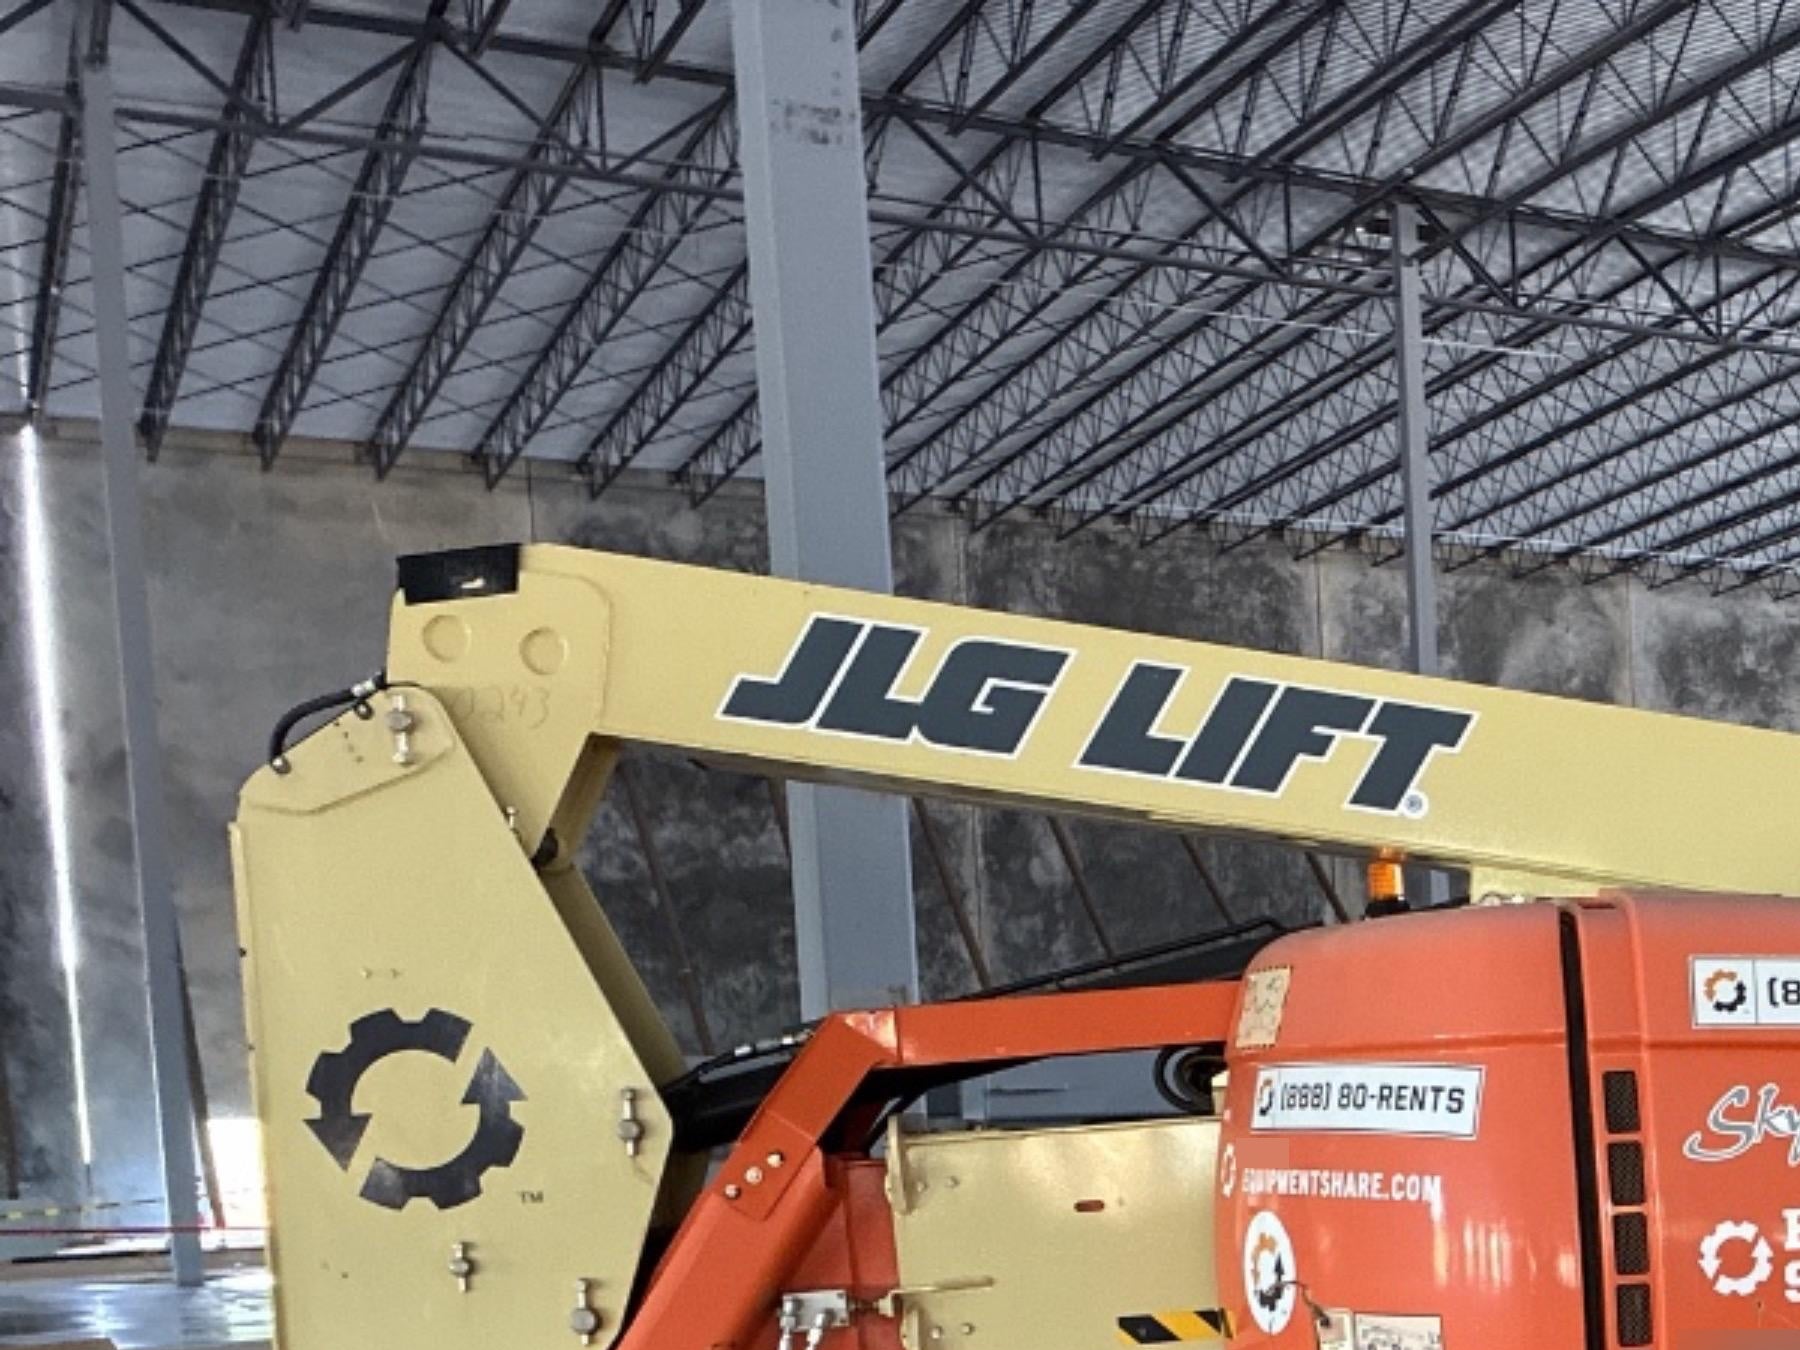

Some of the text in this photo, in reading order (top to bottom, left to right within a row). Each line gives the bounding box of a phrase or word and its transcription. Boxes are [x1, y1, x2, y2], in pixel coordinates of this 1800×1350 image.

[714, 611, 1079, 761] JLG
[1280, 1082, 1466, 1114] (888) 80-RENTS
